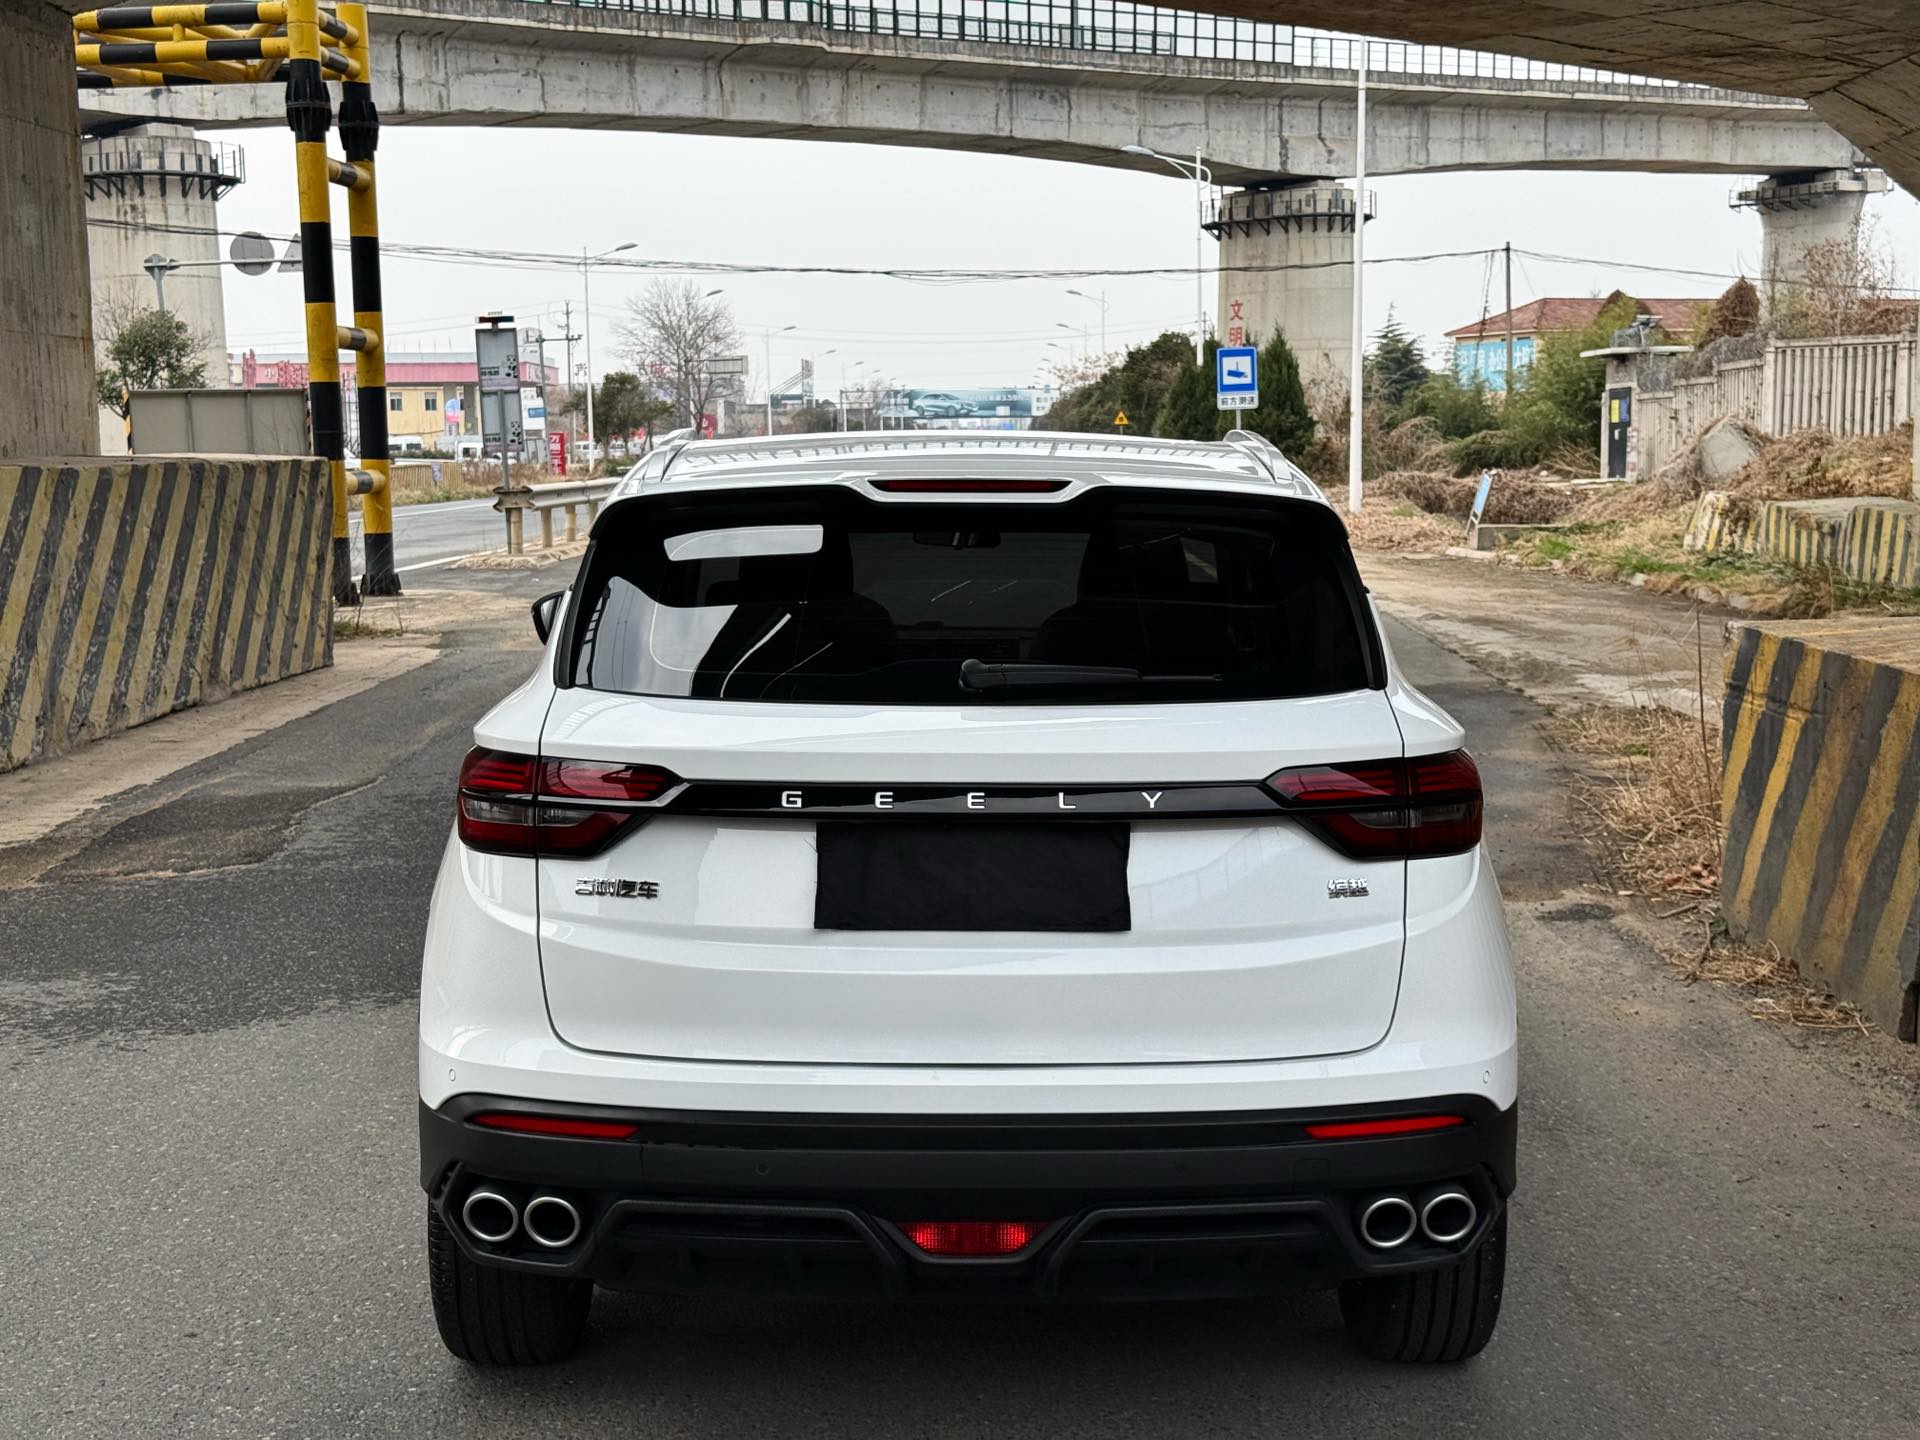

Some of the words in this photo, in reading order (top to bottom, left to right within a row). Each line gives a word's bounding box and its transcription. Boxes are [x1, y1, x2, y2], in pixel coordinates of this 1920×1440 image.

[1221, 396, 1256, 406] 前方测速
[780, 790, 1164, 810] GEELY
[575, 877, 659, 898] 吉利汽车
